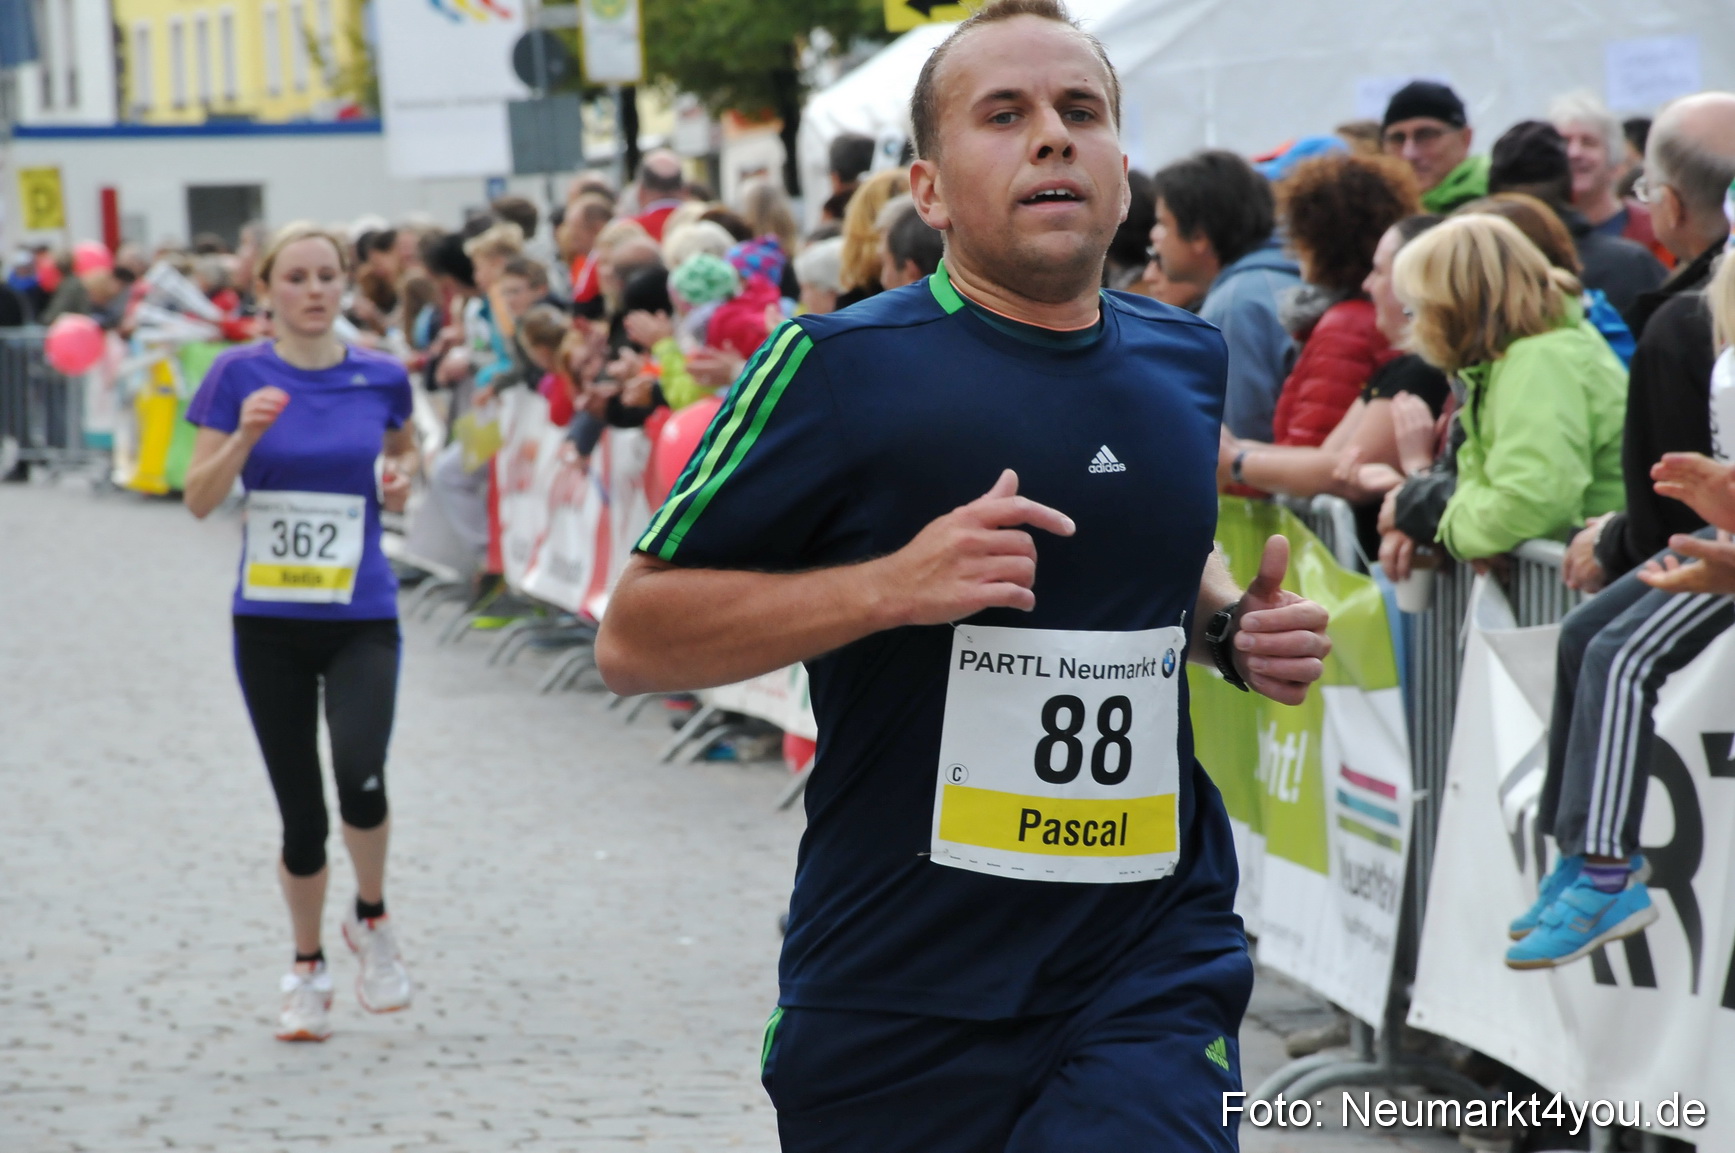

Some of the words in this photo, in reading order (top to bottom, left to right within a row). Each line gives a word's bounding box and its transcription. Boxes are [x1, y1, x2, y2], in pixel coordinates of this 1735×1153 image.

[1088, 462, 1127, 474] adidas
[271, 520, 338, 558] 362
[959, 649, 1051, 678] PARTL
[1059, 656, 1156, 680] Neumarkt
[1034, 694, 1133, 786] 88
[952, 766, 962, 782] C
[1018, 807, 1128, 847] Pascal
